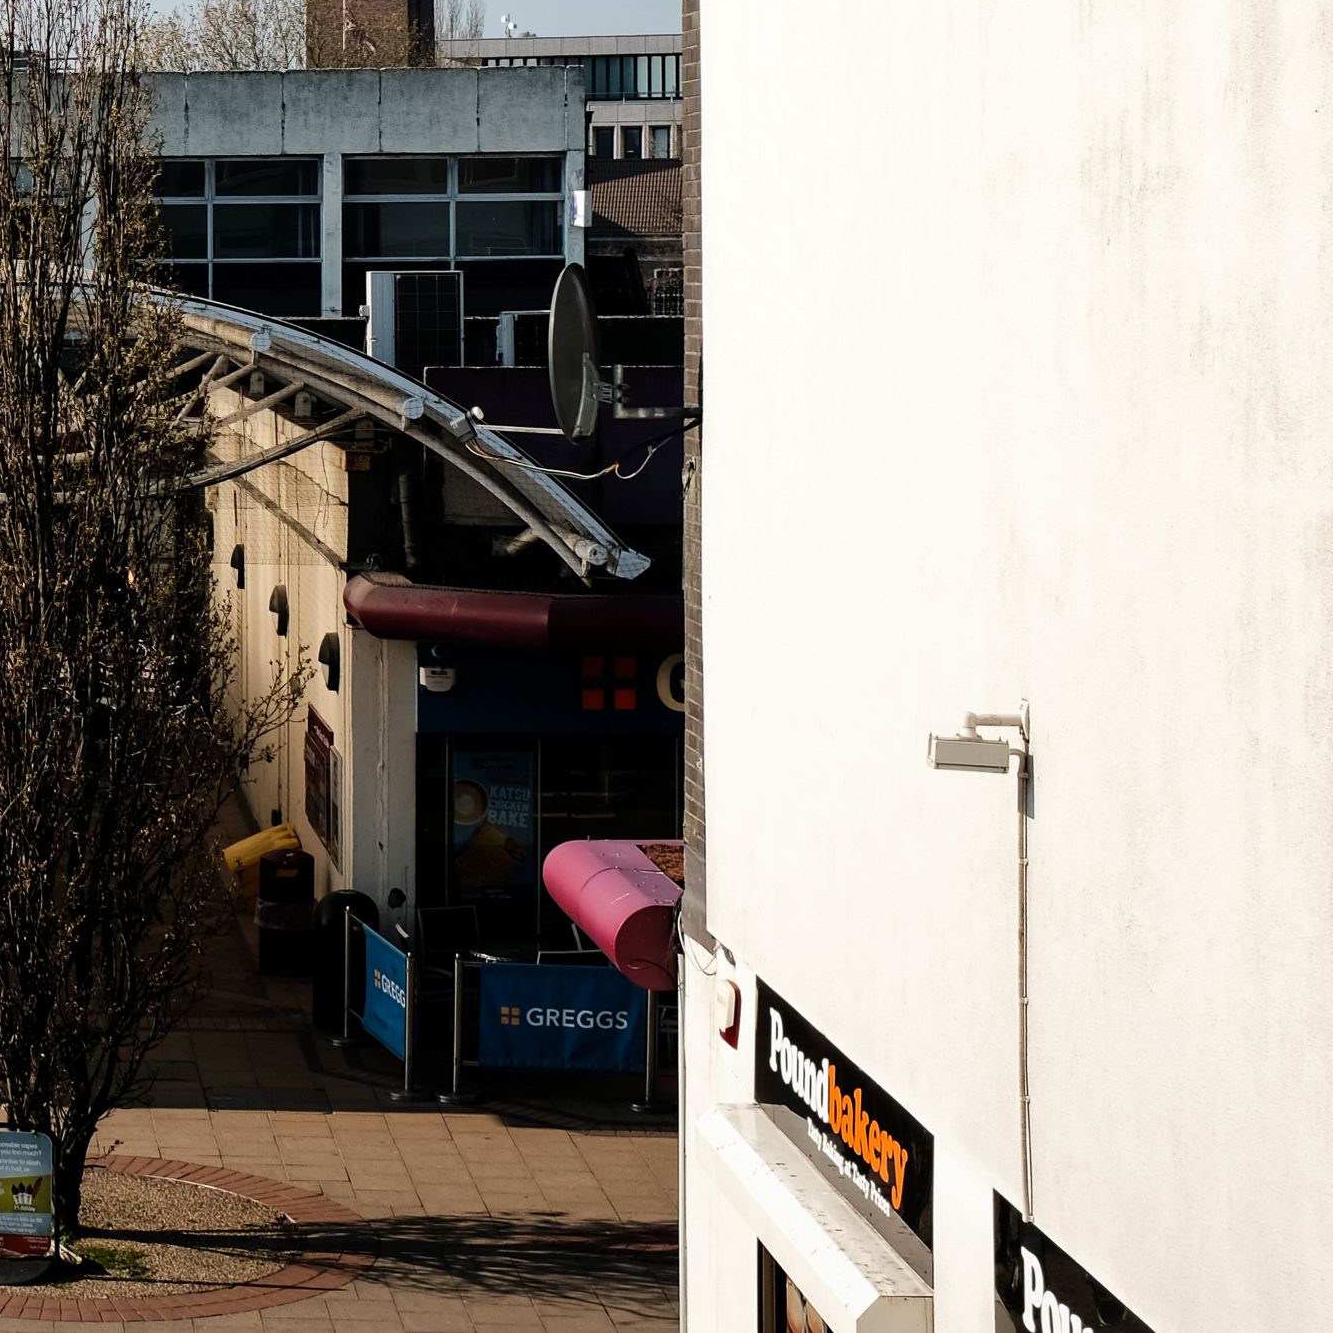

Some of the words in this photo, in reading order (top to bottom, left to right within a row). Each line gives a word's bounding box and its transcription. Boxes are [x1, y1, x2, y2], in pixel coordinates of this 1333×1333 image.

[489, 785, 531, 802] KATSU
[488, 798, 529, 812] CHICKEN
[487, 809, 529, 829] BAKE
[381, 974, 406, 1008] GREGG
[526, 1007, 629, 1030] GREGGS
[769, 1007, 909, 1211] Poundbakery
